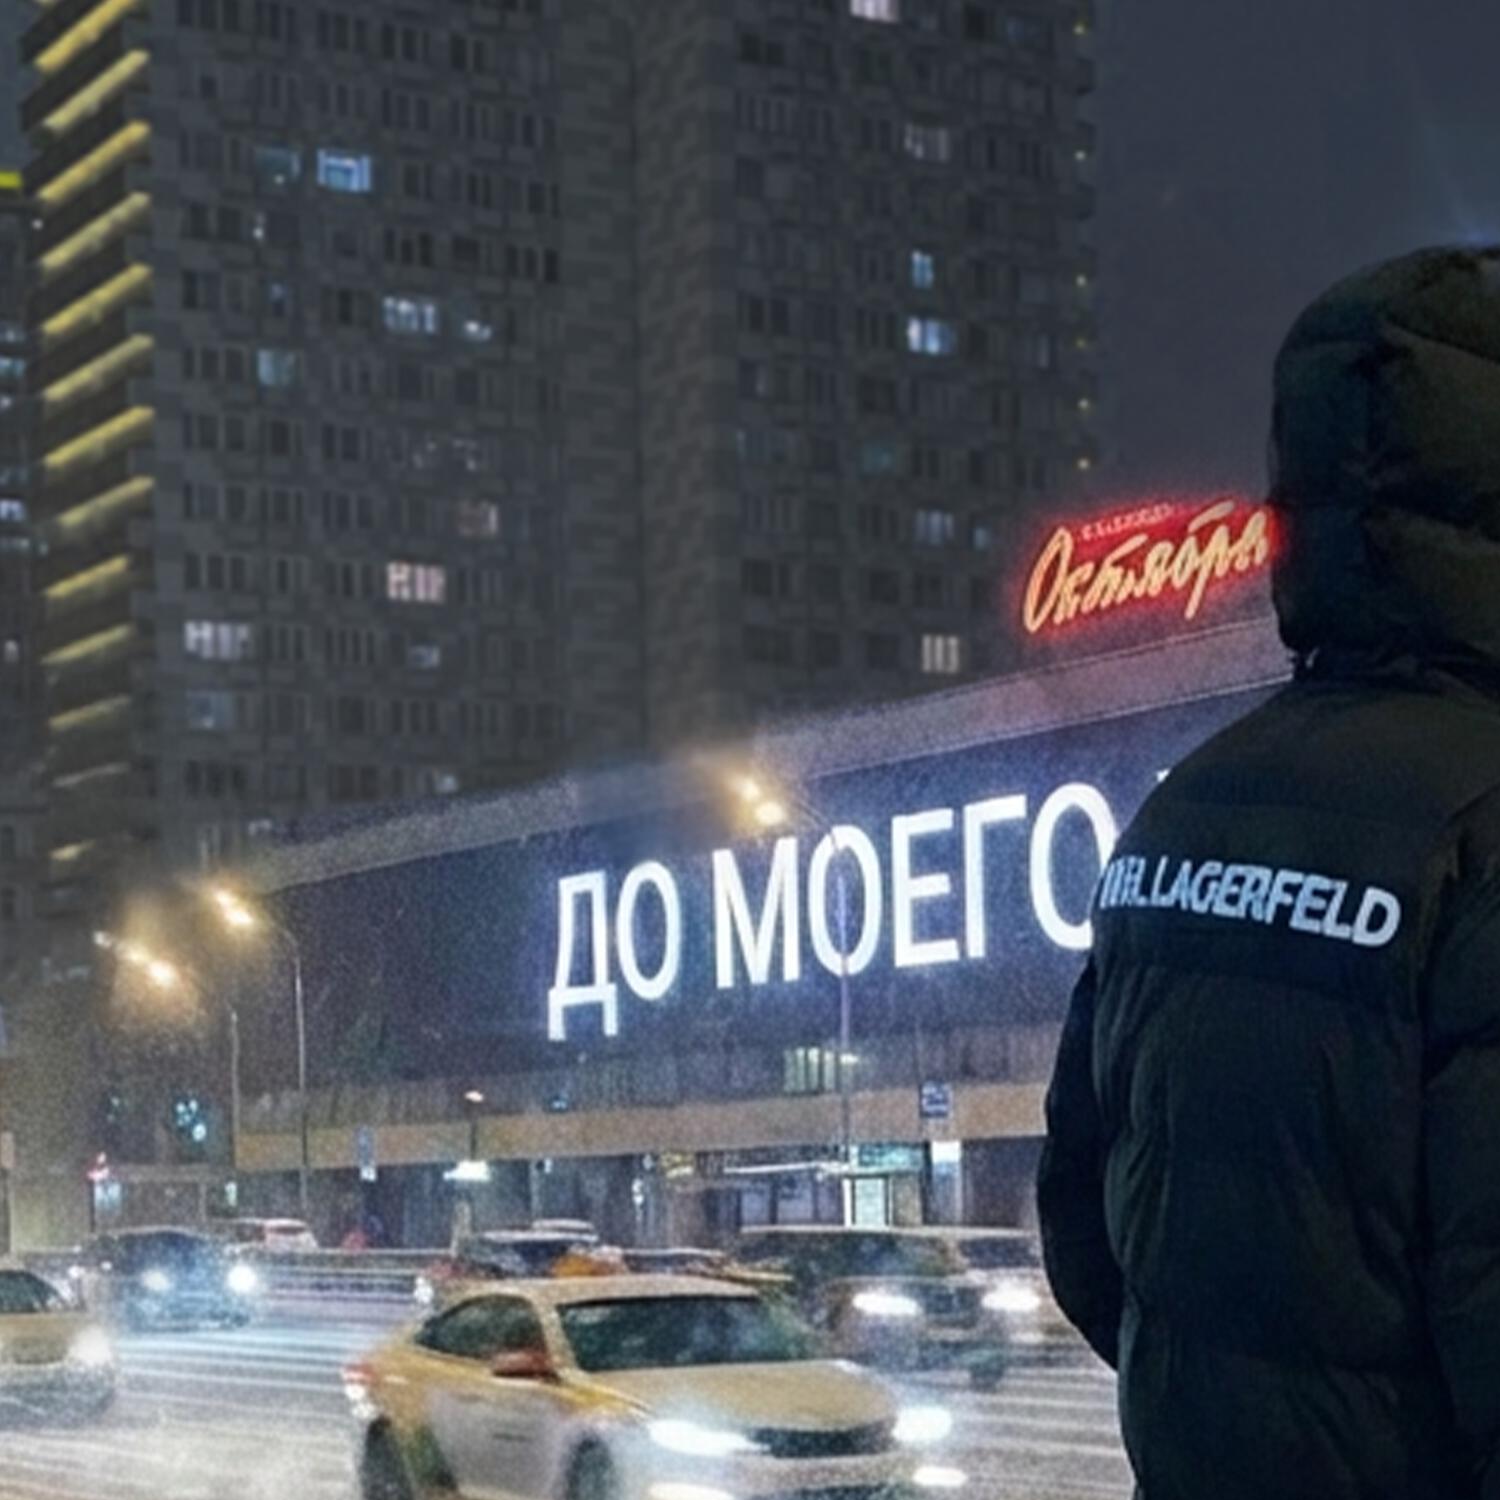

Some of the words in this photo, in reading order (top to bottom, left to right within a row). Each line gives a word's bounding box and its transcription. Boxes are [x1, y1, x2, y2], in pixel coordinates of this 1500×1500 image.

[548, 860, 681, 1041] ДО
[711, 782, 1119, 989] МОЕГО
[1150, 855, 1400, 947] LAGERFELD
